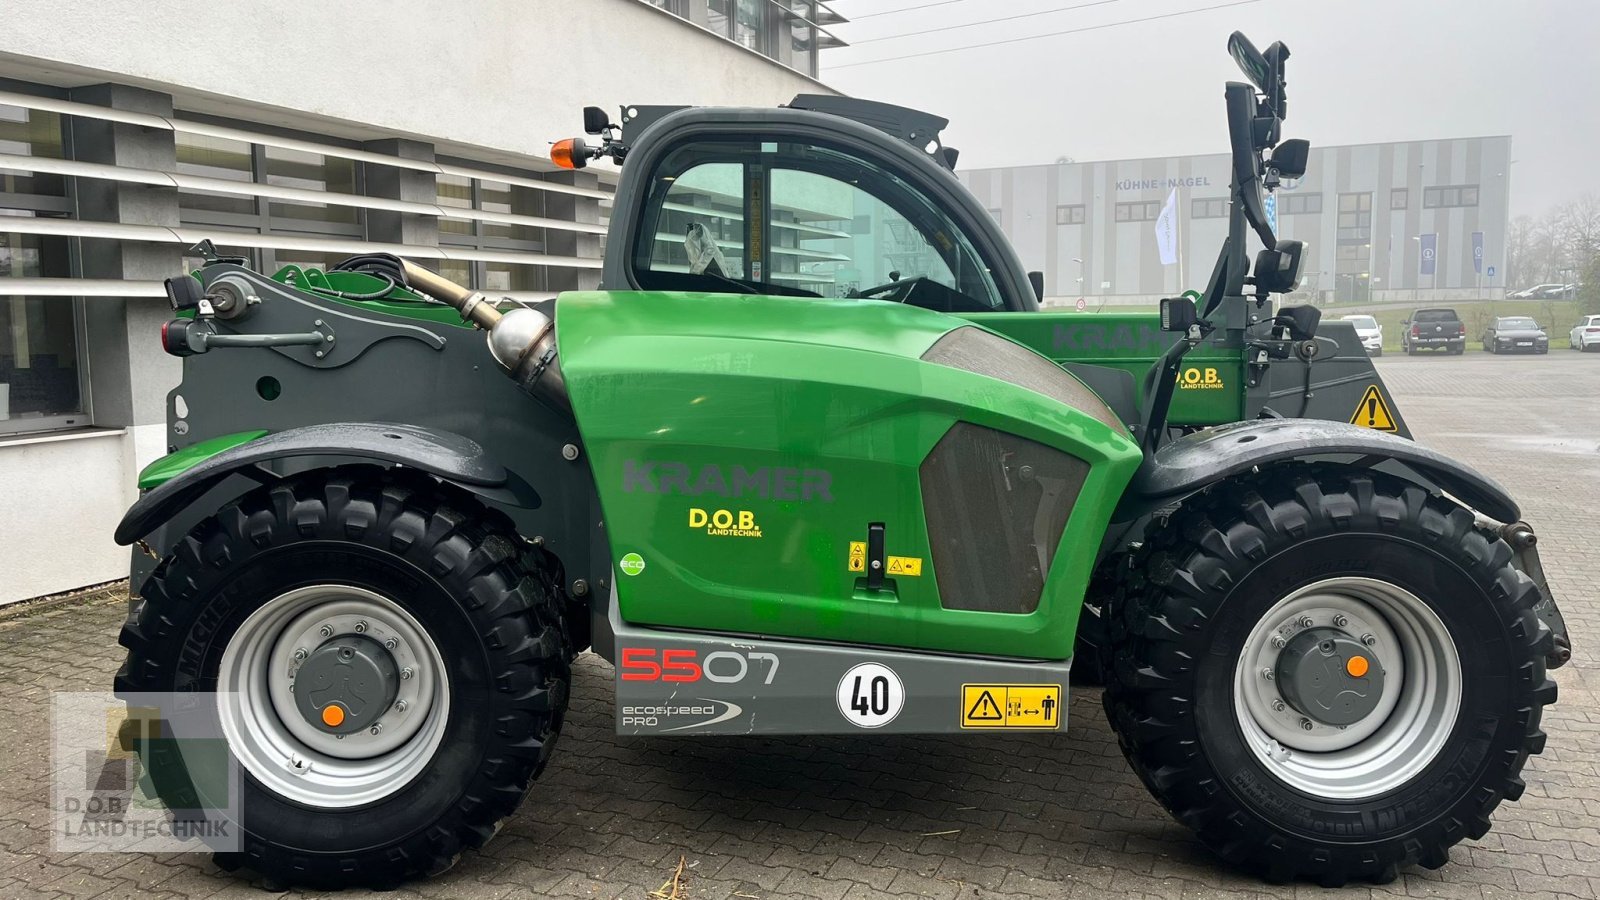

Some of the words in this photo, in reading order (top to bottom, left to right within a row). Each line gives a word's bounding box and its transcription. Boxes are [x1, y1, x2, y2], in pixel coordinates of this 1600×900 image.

[1053, 324, 1172, 349] KRAM
[623, 461, 834, 500] KRAMER
[689, 508, 760, 531] D.O.B.
[707, 528, 763, 538] LANDTECHNIK
[621, 649, 779, 685] 5507
[851, 675, 889, 716] 40
[622, 705, 714, 720] ecospeed
[622, 717, 658, 727] PRO
